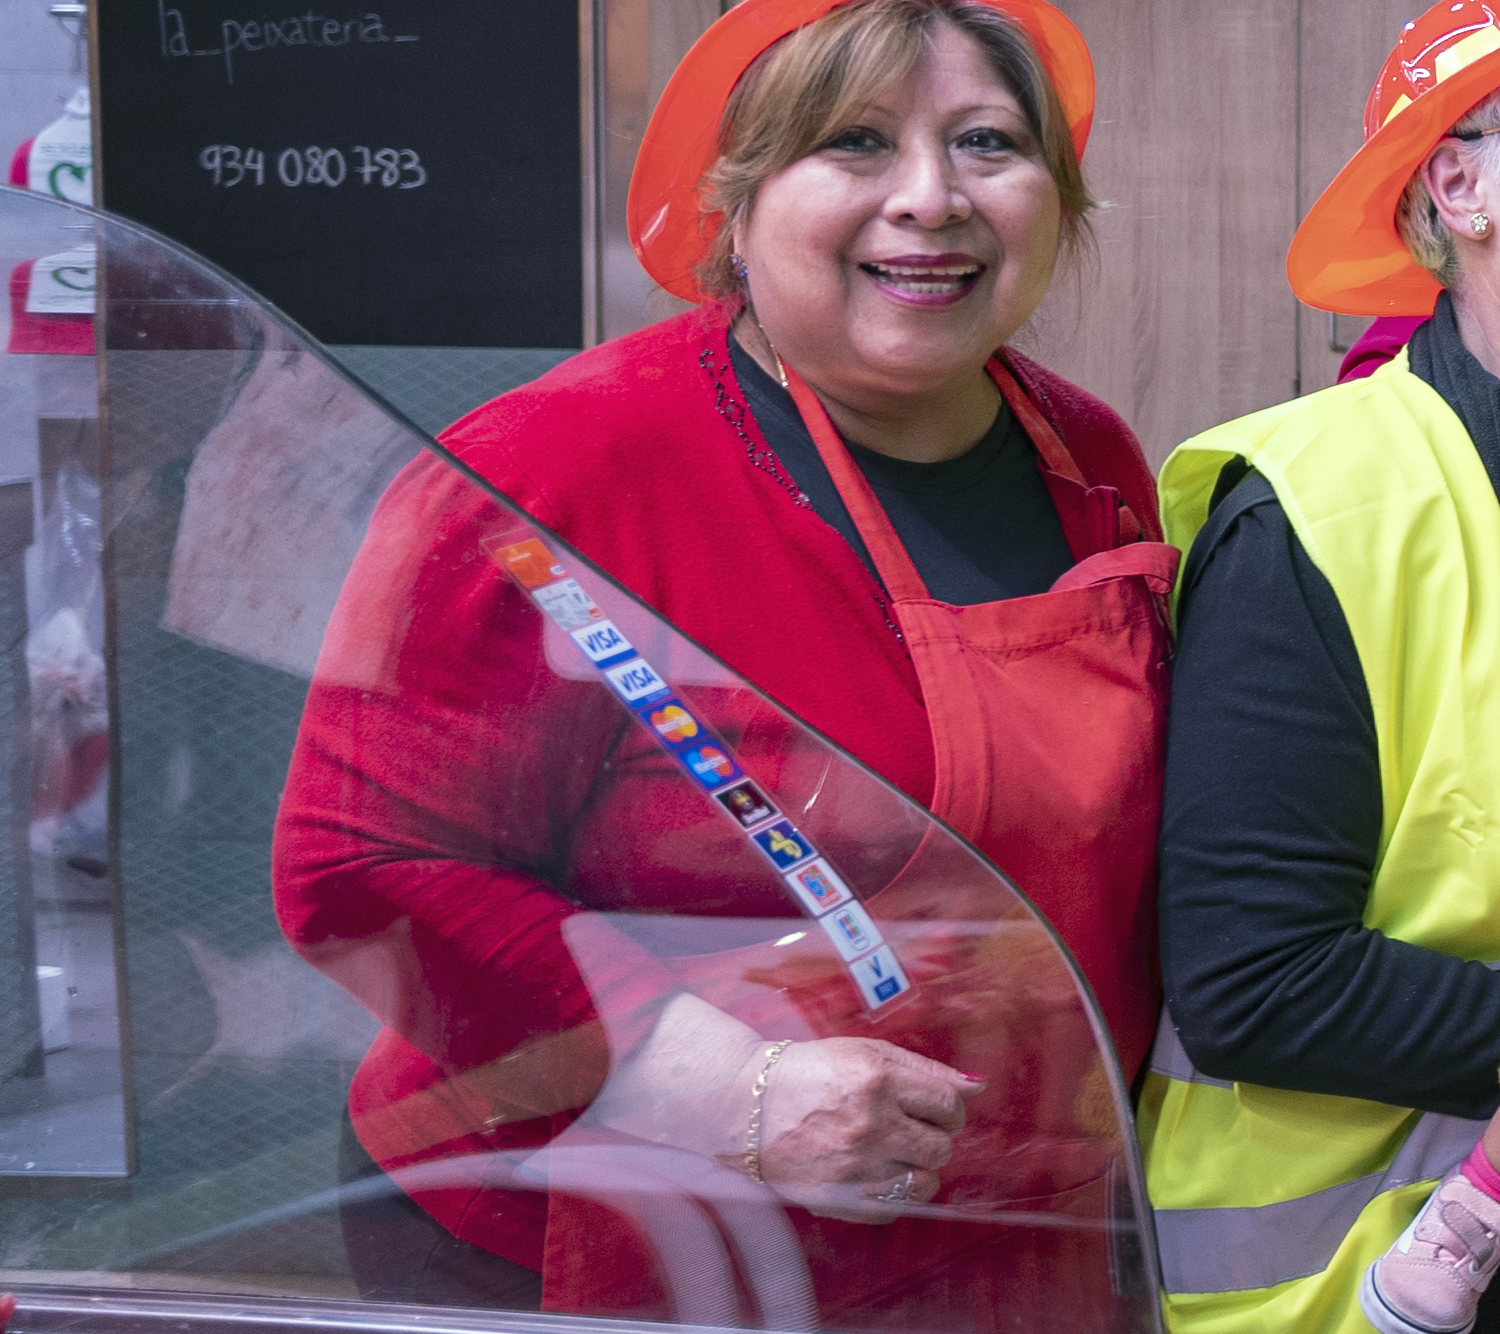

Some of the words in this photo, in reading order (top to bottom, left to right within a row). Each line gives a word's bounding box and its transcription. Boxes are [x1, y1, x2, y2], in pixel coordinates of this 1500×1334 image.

[201, 145, 265, 188] 934
[277, 145, 347, 188] 080
[353, 145, 427, 189] 783
[585, 627, 624, 654] VISA
[618, 667, 658, 693] VISA
